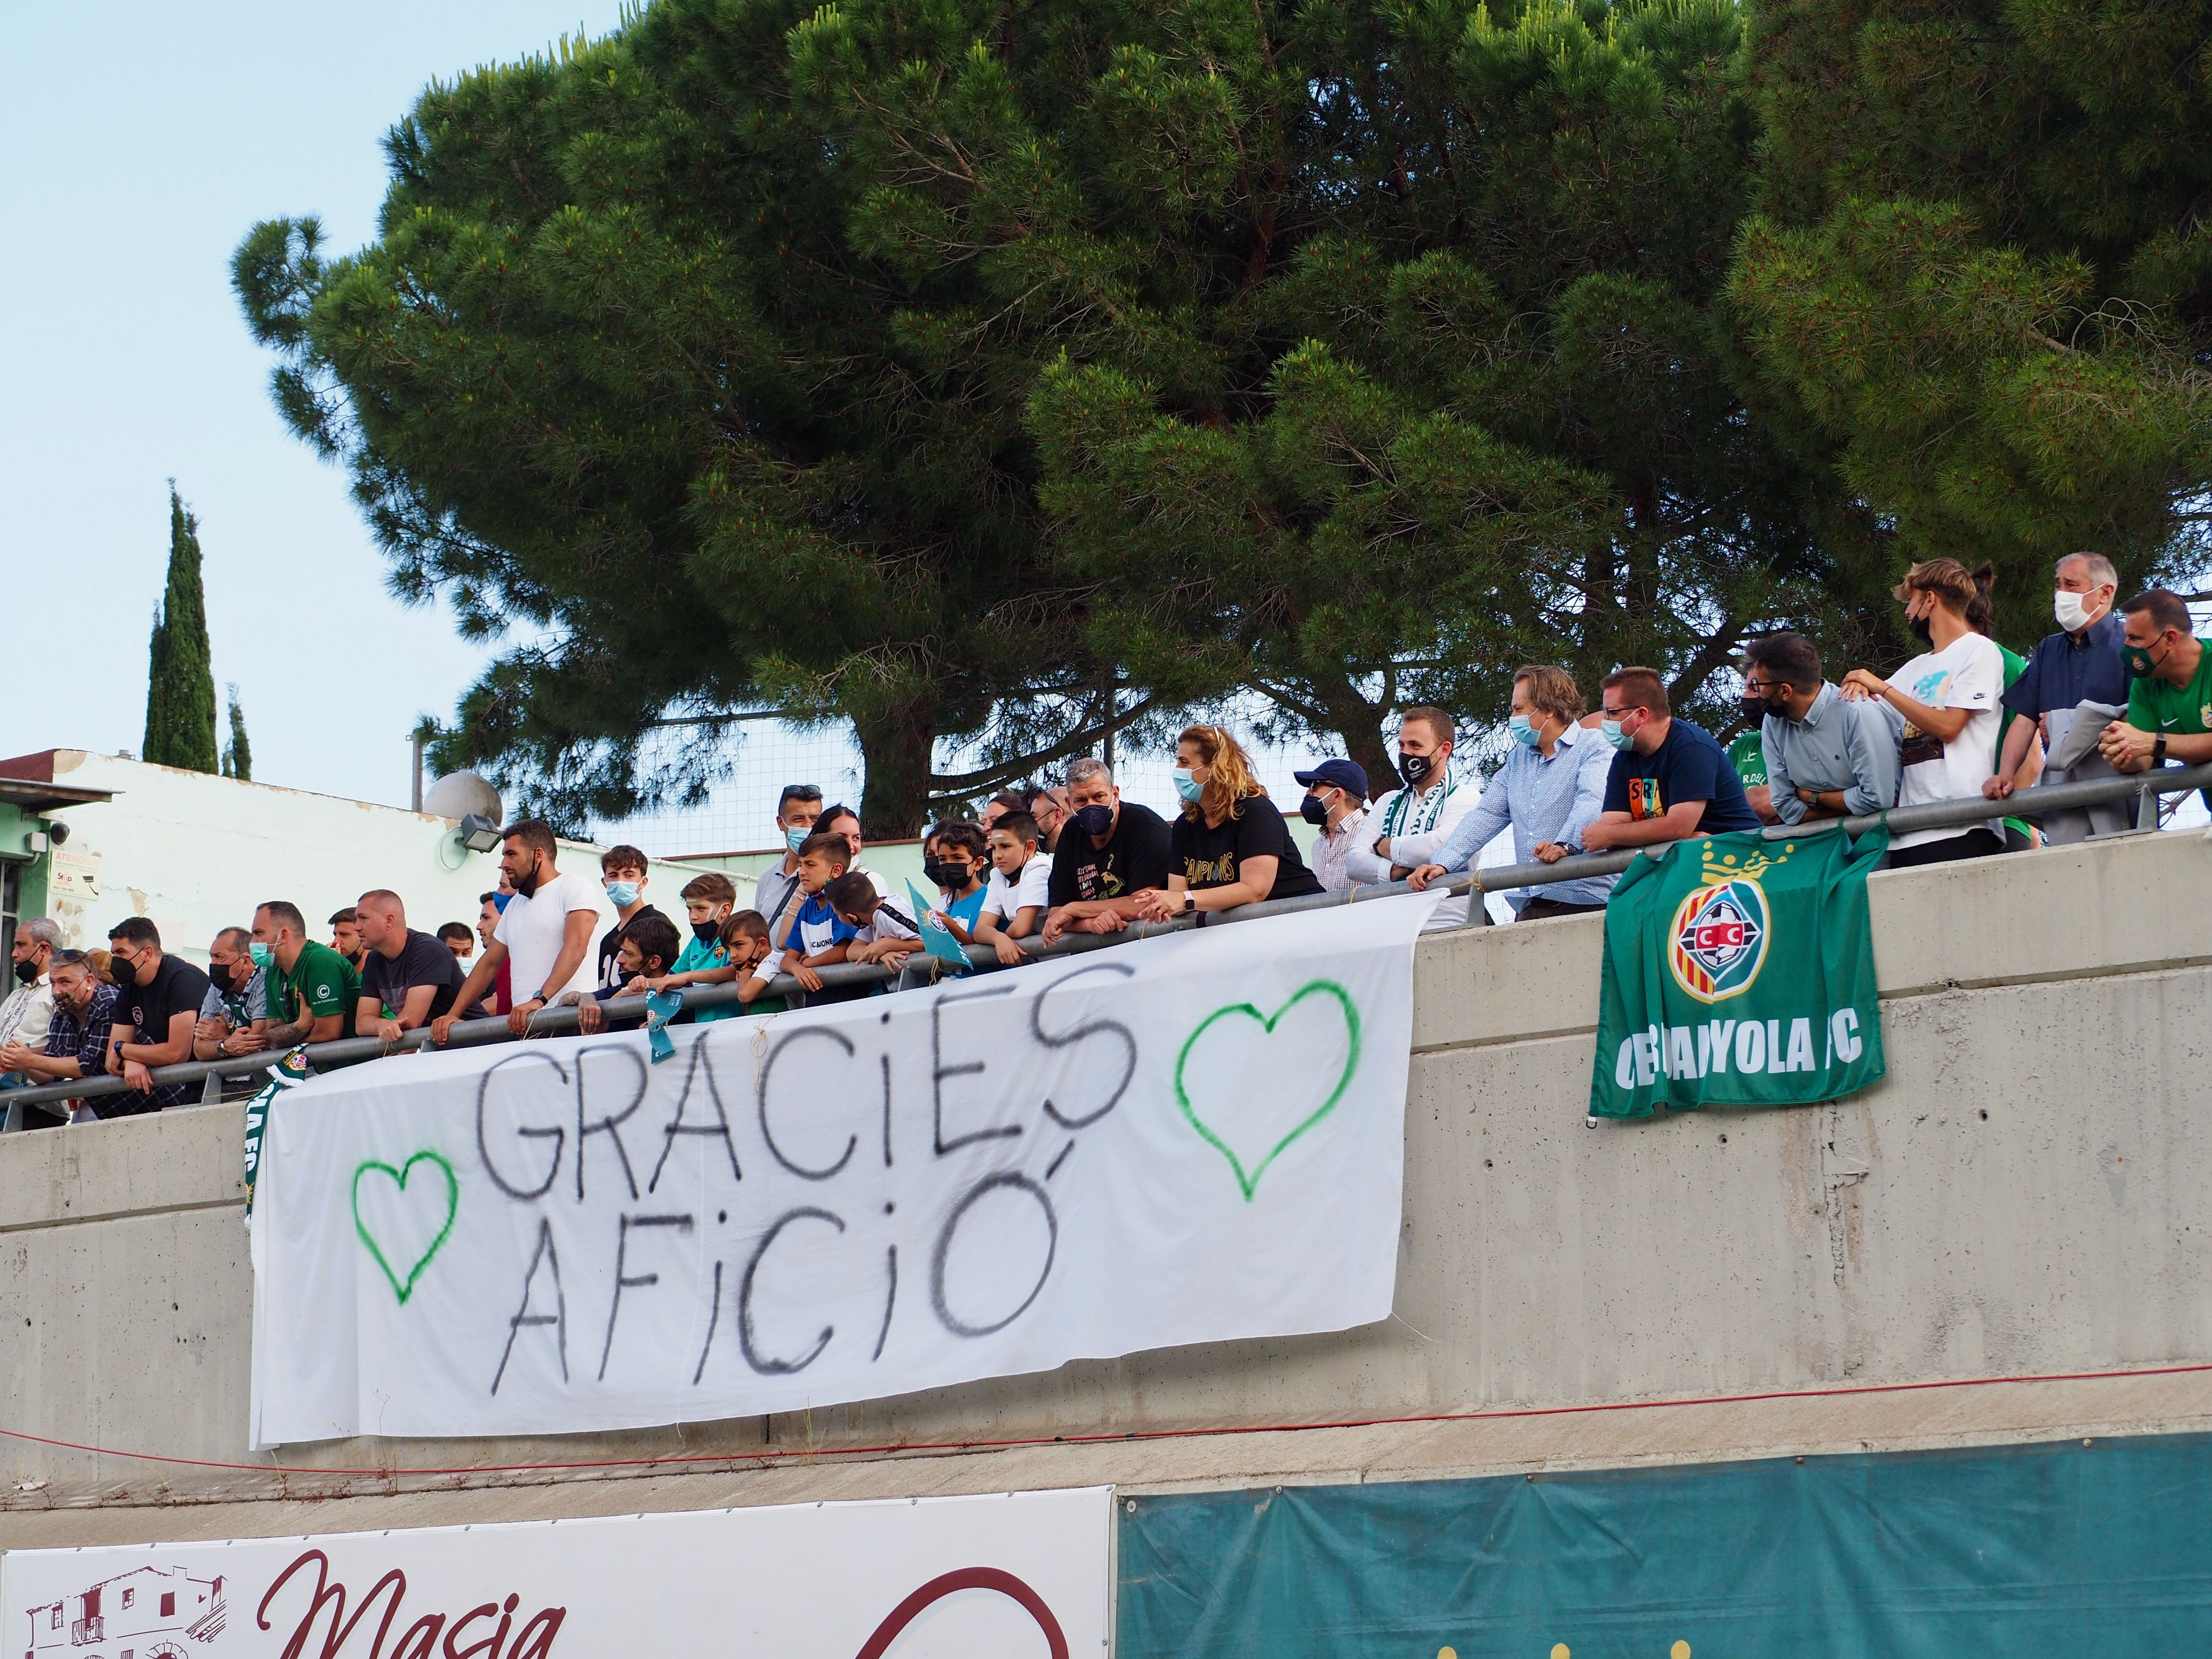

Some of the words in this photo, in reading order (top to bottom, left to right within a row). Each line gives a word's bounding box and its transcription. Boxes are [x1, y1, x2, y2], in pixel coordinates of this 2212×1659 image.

[1700, 929, 1712, 945] C
[1727, 927, 1740, 943] C
[1825, 1008, 1863, 1070] C
